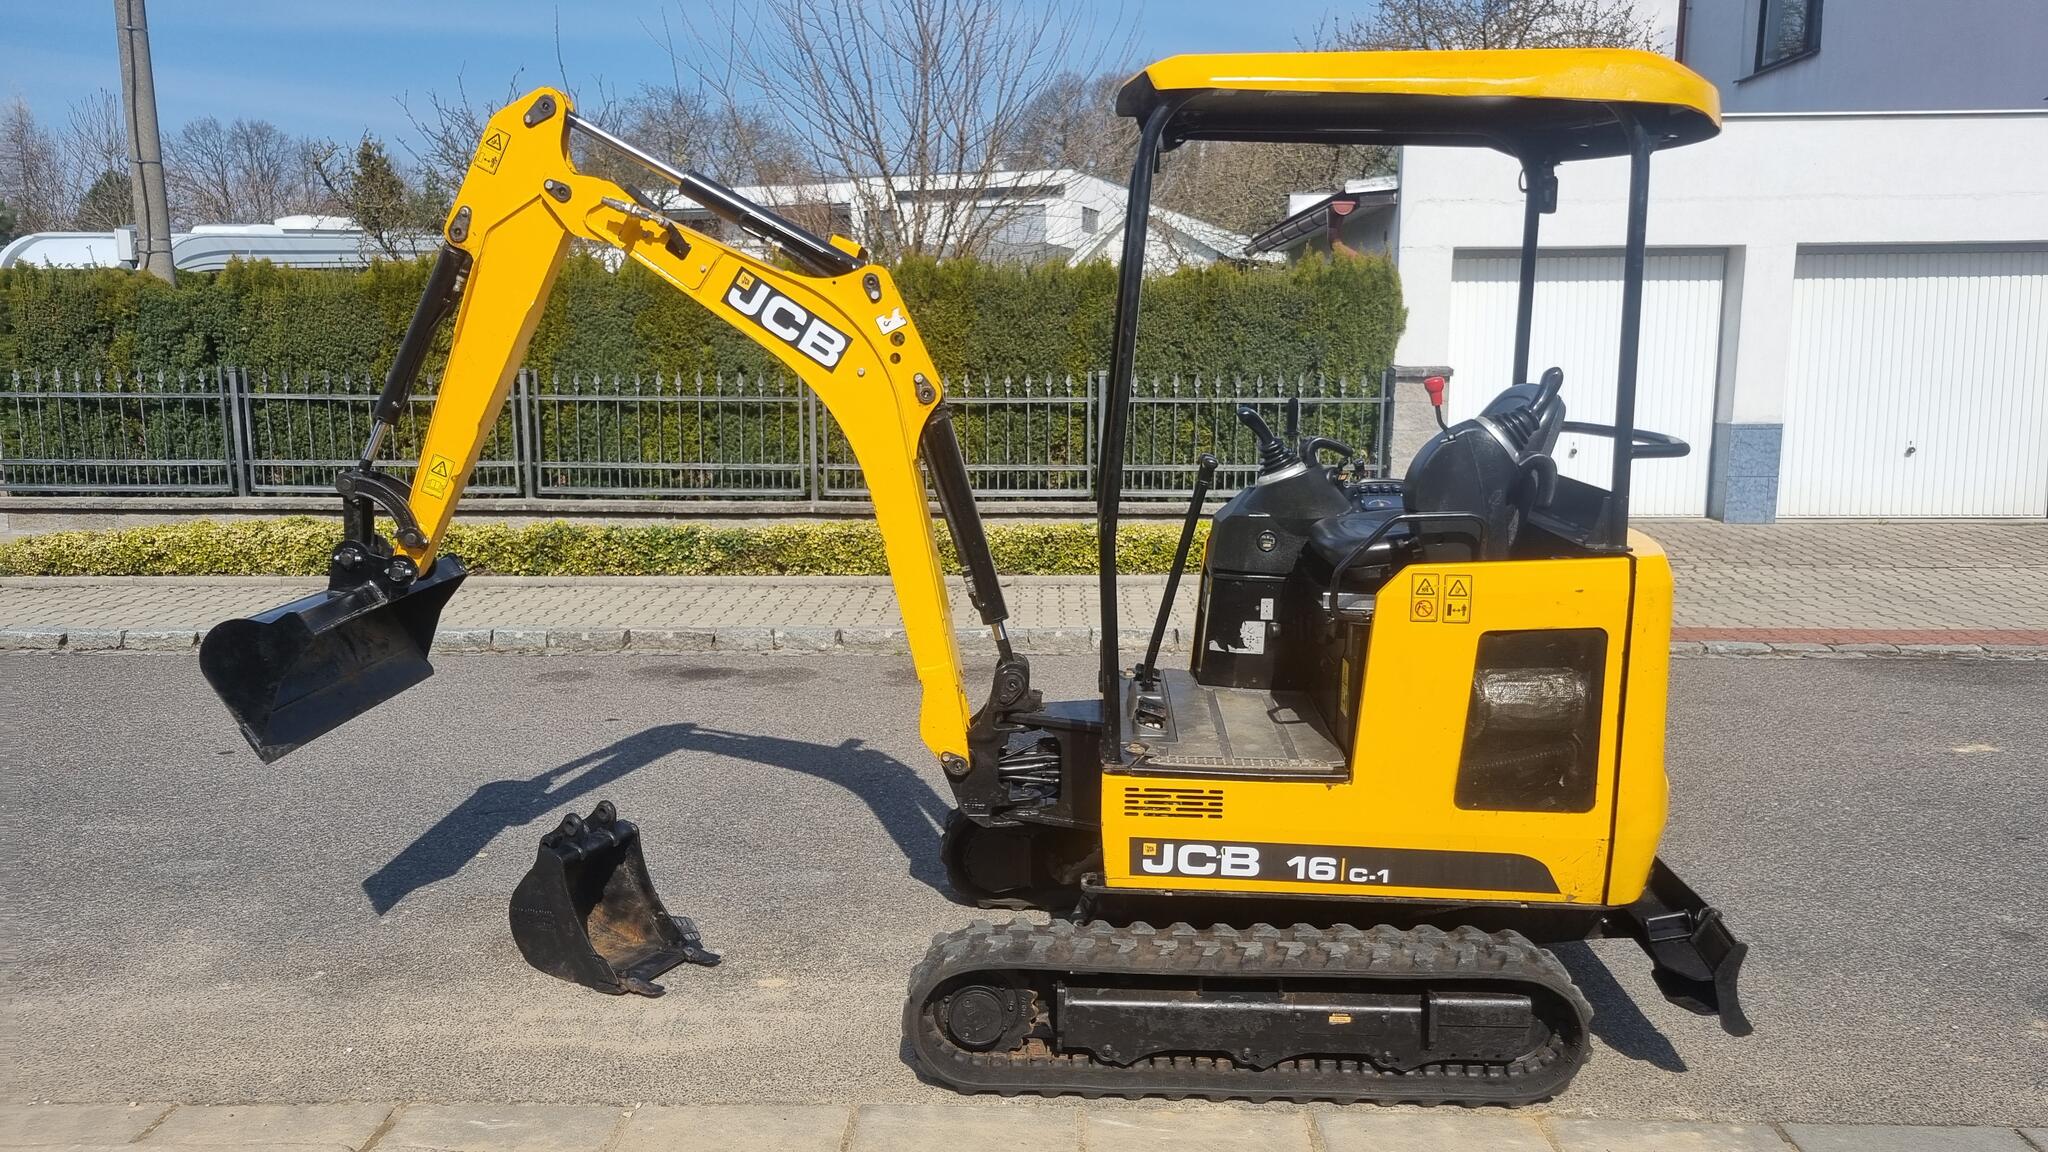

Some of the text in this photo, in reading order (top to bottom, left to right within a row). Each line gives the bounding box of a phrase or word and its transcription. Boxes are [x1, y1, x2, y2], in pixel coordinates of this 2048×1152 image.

[728, 283, 846, 367] JCB
[1142, 843, 1260, 877] JCB
[1286, 856, 1337, 880] 16
